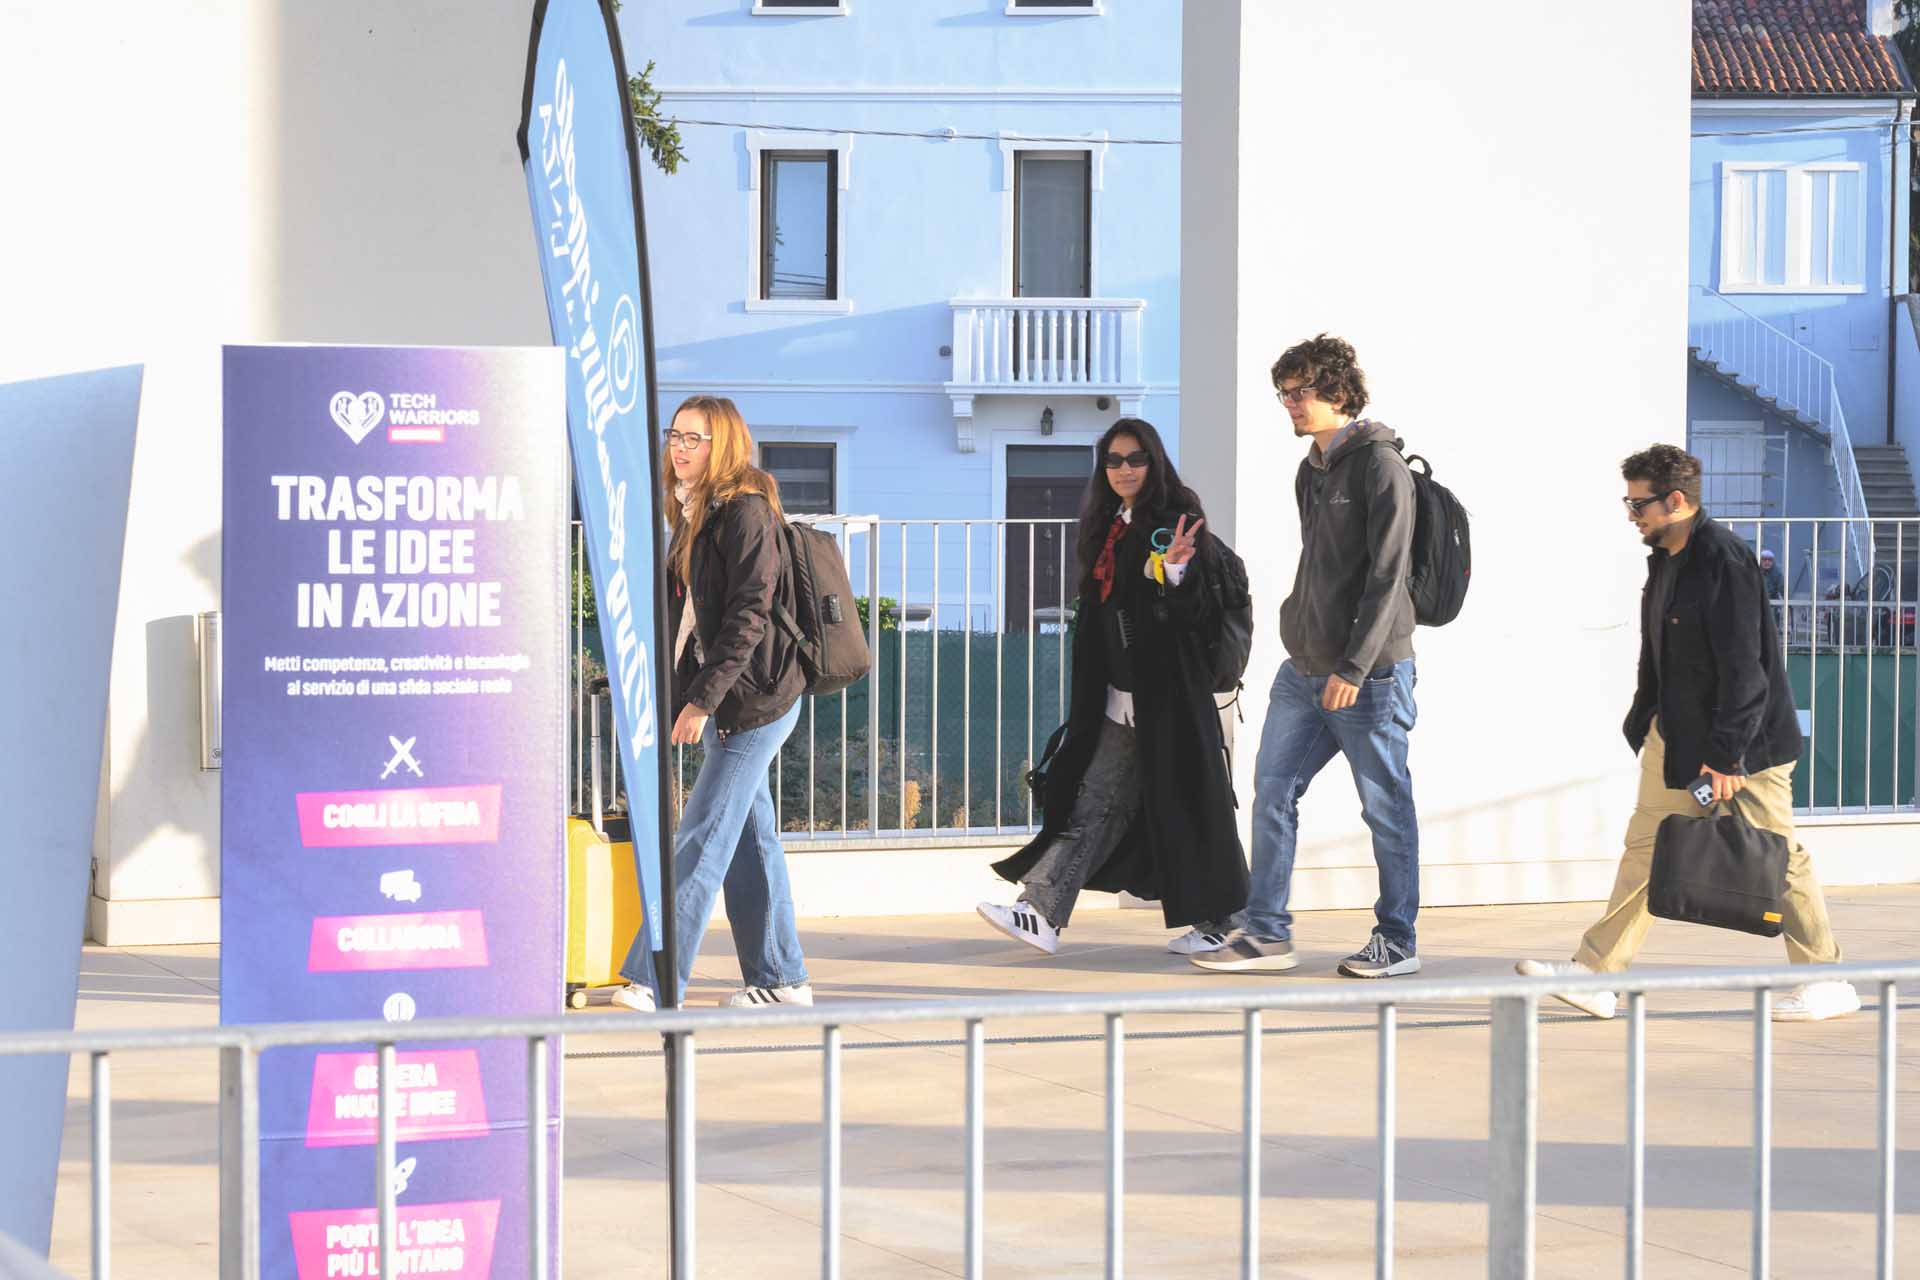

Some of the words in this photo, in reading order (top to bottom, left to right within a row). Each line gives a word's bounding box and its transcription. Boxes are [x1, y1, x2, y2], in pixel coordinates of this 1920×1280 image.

[390, 393, 436, 408] TECH
[389, 409, 480, 425] WARRIORS
[270, 475, 525, 521] TRASFORMA
[328, 529, 376, 575] LE
[385, 529, 475, 575] IDEE
[297, 583, 343, 628] IN
[352, 581, 502, 628] AZIONE
[264, 655, 300, 671] Metti
[287, 679, 300, 696] al
[302, 679, 354, 696] servizio
[356, 679, 370, 696] di
[371, 681, 398, 696] una
[389, 801, 417, 828] LA
[354, 1063, 438, 1090] GEERA
[327, 1248, 364, 1278] PIÙ
